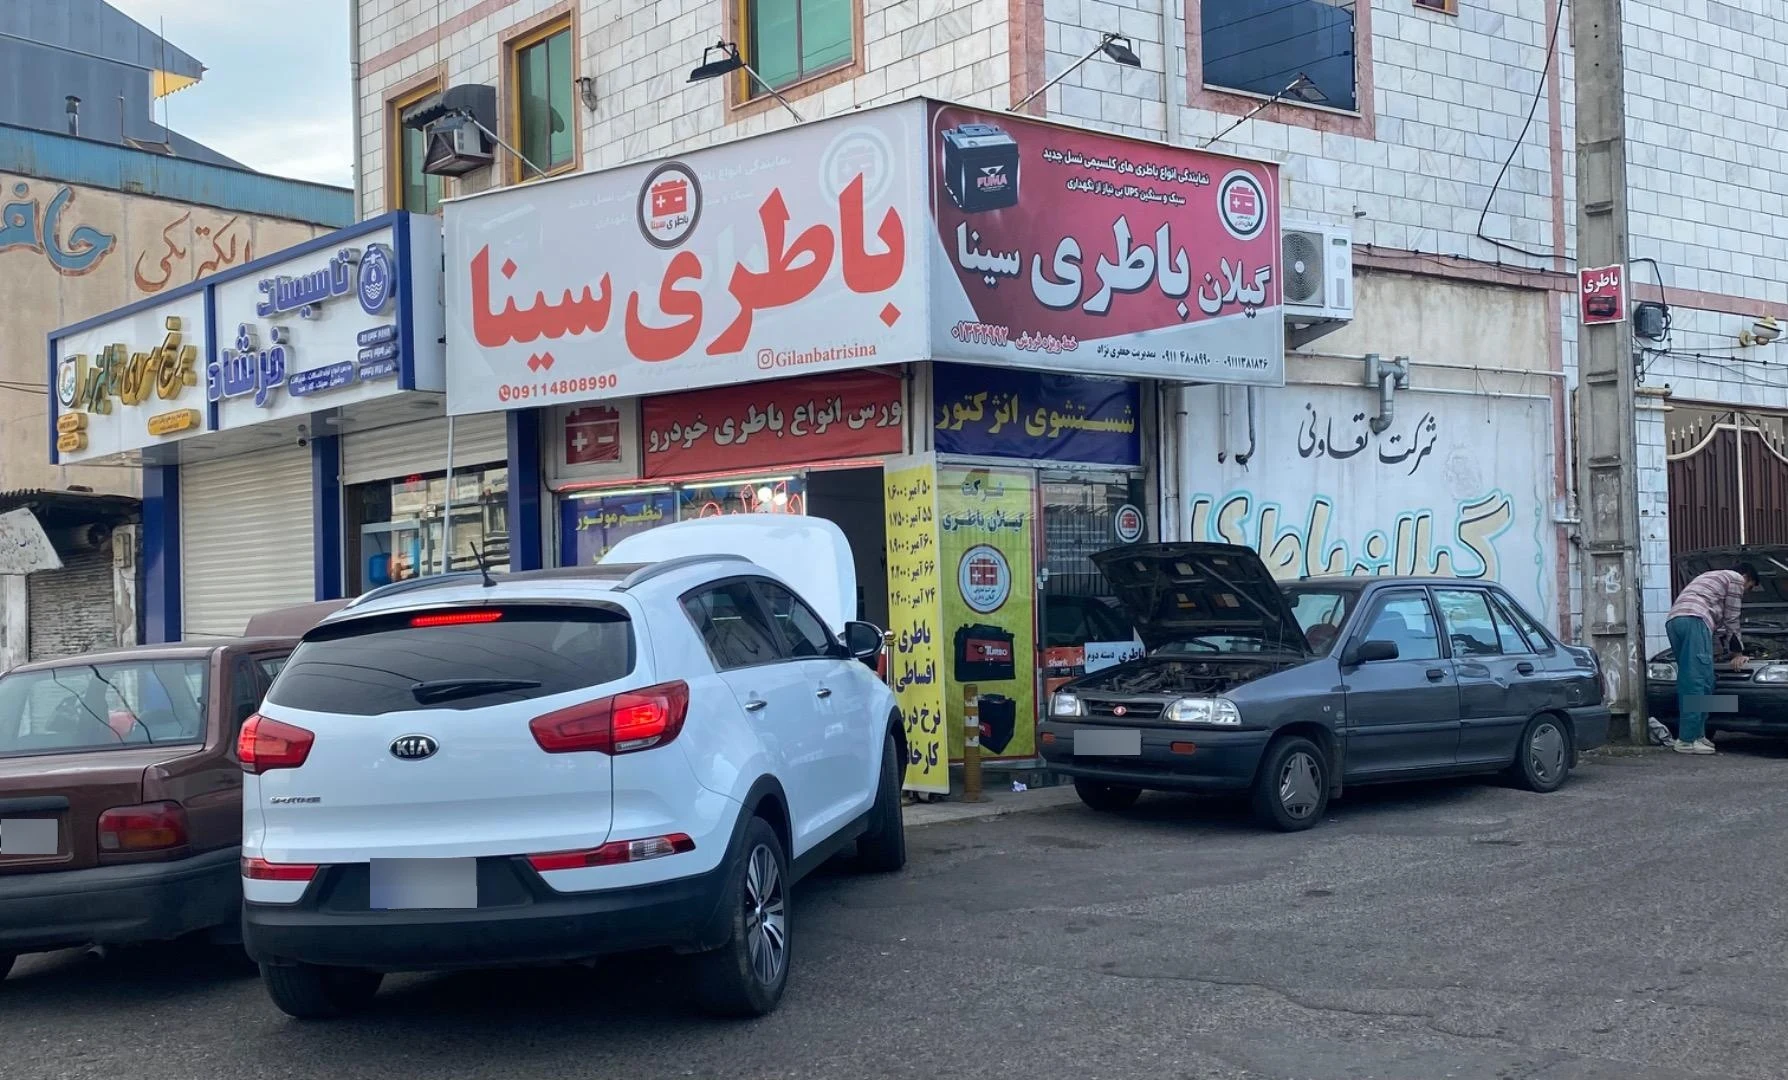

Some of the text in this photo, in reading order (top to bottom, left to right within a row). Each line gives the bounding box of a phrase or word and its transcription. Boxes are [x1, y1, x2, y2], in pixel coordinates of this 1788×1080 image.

[1043, 148, 1210, 187] نمایندگی انواع باطری های کلسیمی نسل جدید
[1066, 178, 1186, 205] سبک و سنگین UPS بی نیاز از نگهداری
[470, 172, 905, 372] باطری سینا
[956, 214, 1272, 319] گیلان باطری سینا
[256, 247, 353, 320] تاسیسات
[1583, 271, 1619, 294] باطری
[775, 343, 877, 368] Gilanbatrisina
[512, 374, 618, 400] 09114808990
[648, 397, 902, 453] ورس انواع باطری خودرو
[935, 391, 1135, 438] شستشوی انژکتور
[1297, 402, 1370, 459] تعاونی
[1378, 411, 1438, 476] شرکت
[922, 480, 931, 495] ۵۰
[961, 479, 1004, 502] شرکت
[575, 503, 663, 531] تنظیم موتور
[923, 506, 932, 522] ۵۵
[943, 506, 1024, 532] گیلان باطری
[924, 533, 933, 549] ۶۰
[924, 560, 934, 576] ۶۶
[925, 587, 935, 604] ۷۴
[898, 619, 931, 653] باطری
[896, 658, 936, 692] اقساطی
[901, 700, 941, 734] نرخ در
[396, 739, 430, 756] KIA
[907, 741, 939, 775] کارخا
